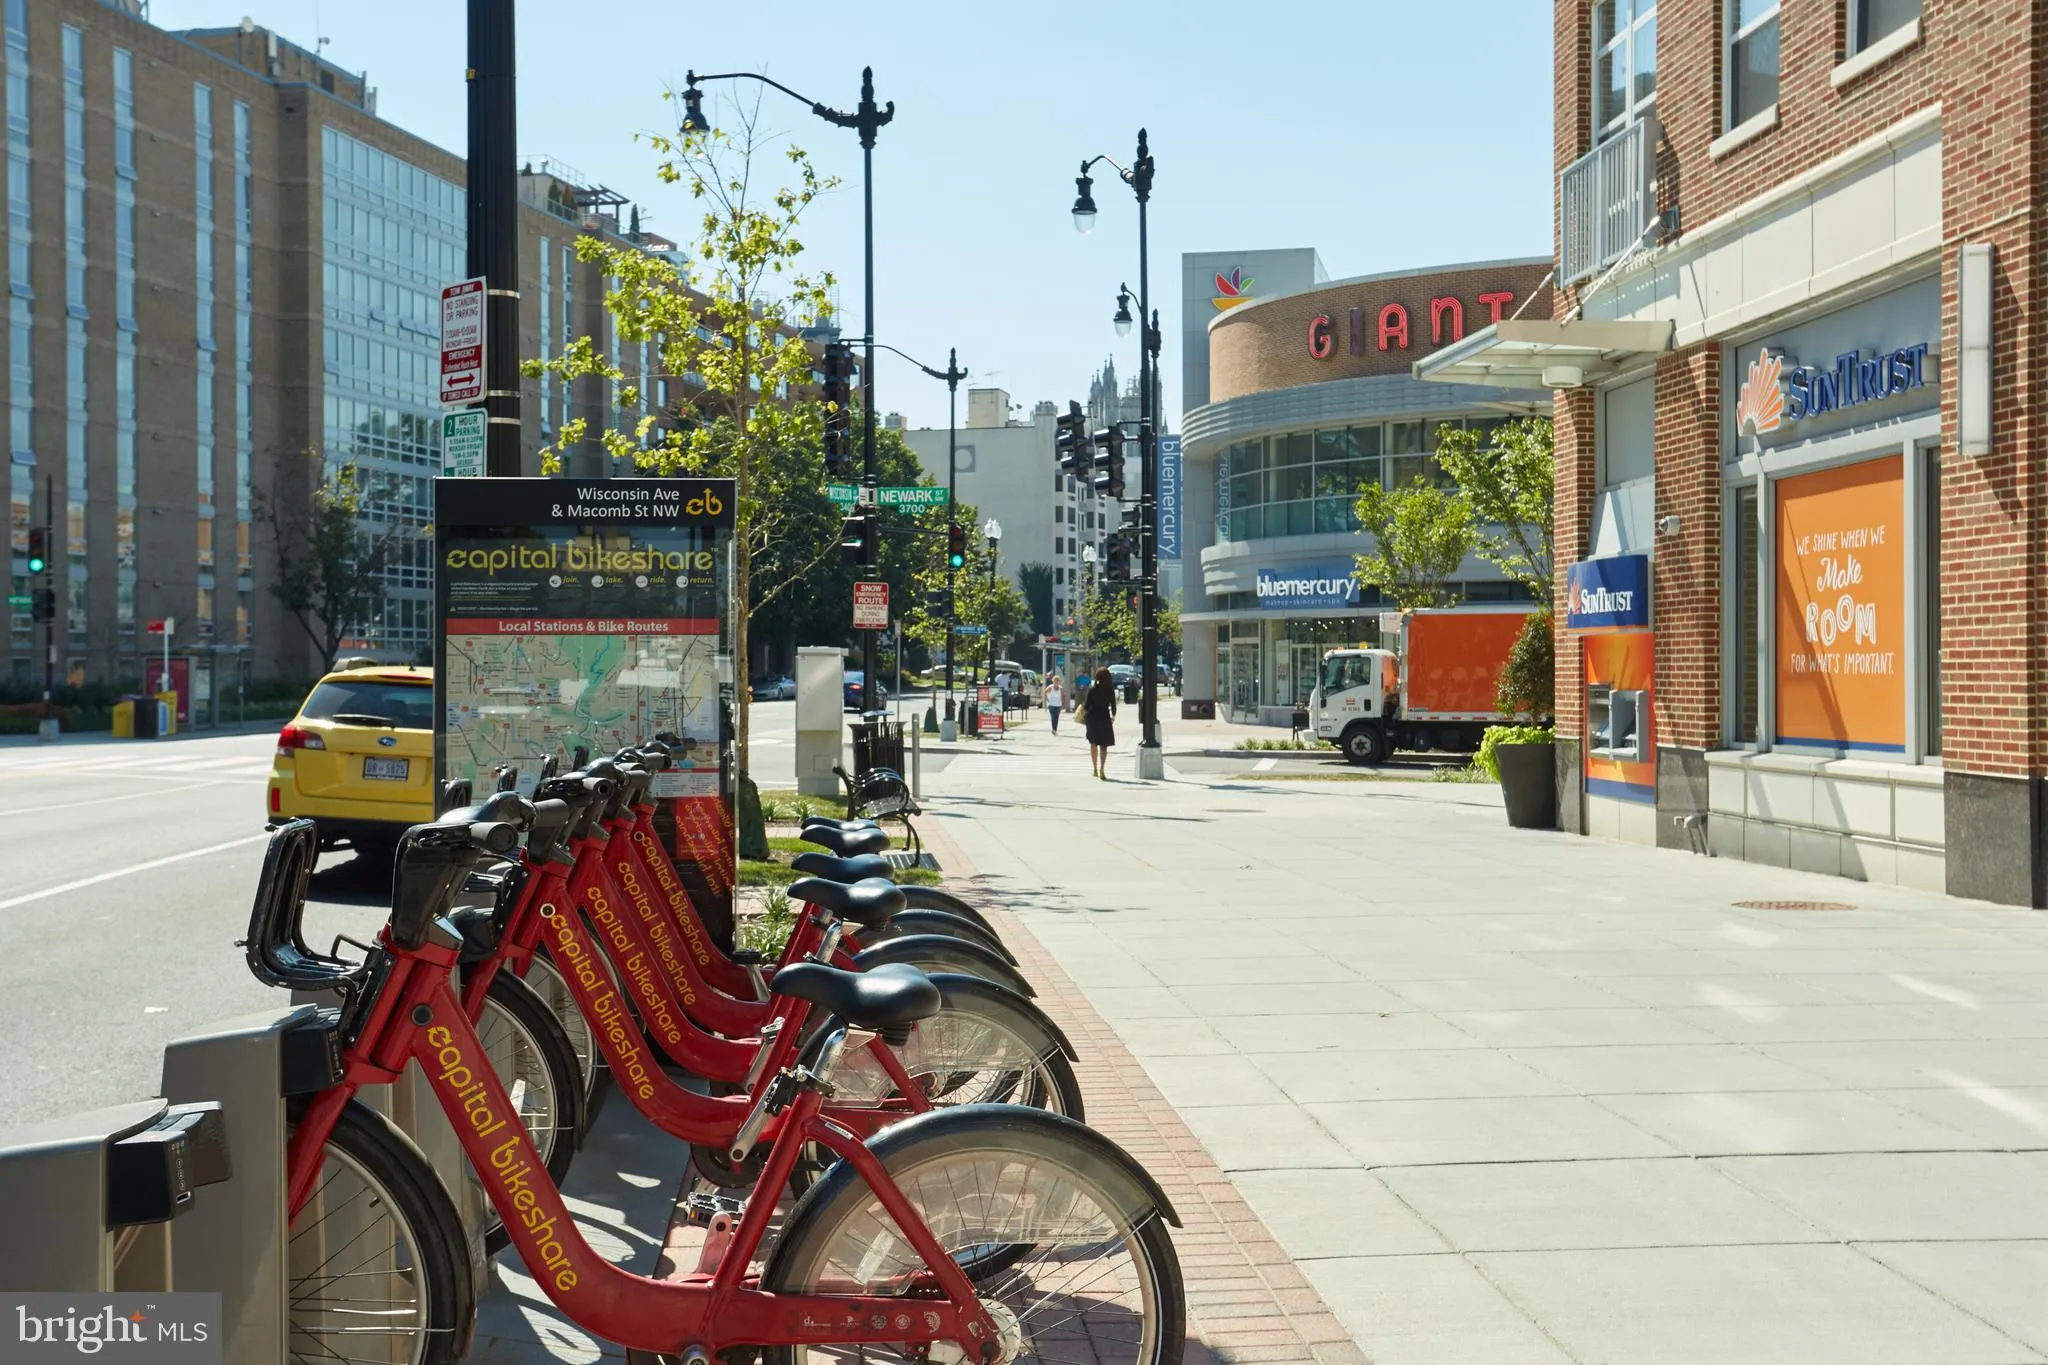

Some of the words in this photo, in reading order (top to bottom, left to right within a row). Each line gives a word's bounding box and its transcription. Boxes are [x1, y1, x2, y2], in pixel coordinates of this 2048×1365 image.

[446, 300, 454, 310] NO
[455, 295, 479, 309] STANDING
[446, 311, 454, 322] OR
[455, 306, 479, 319] PARKING
[1308, 292, 1514, 361] GIANT
[448, 347, 476, 361] EMERGENCY
[447, 419, 453, 435] 2
[455, 425, 481, 436] PARKING
[458, 415, 478, 426] HOUR
[577, 487, 650, 501] Wisconsin
[653, 488, 680, 501] Ave
[829, 487, 852, 500] WISCONSIN
[880, 490, 933, 503] NEWARK
[1158, 440, 1180, 555] bluemercury
[551, 505, 563, 517] &
[568, 504, 630, 517] Macomb
[634, 504, 649, 517] St
[653, 504, 679, 517] NW
[899, 504, 925, 513] 3700
[1796, 535, 1810, 556] WE
[1812, 532, 1838, 553] SHINE
[1840, 528, 1868, 550] WHEN
[1870, 525, 1886, 545] WE
[447, 543, 557, 576] capital
[567, 539, 713, 571] bikeshare
[1816, 553, 1864, 593] Make
[860, 584, 882, 592] SNOW
[1256, 575, 1357, 600] bluemercury
[499, 619, 531, 632] Local
[534, 620, 584, 632] Stations
[586, 620, 596, 632] &
[598, 619, 624, 632] Bike
[627, 620, 669, 632] Routes
[1805, 594, 1877, 647] ROOM
[1790, 652, 1806, 673] FOR
[1808, 652, 1841, 674] WHAT'S
[1844, 651, 1895, 675] IMPORTANT.
[641, 836, 678, 897] capital
[668, 890, 711, 967] bikeshare
[617, 862, 660, 923] capital
[649, 920, 697, 1006] bikeshare
[587, 886, 636, 954] capital
[626, 951, 682, 1045] bikeshare
[550, 914, 605, 992] capital
[593, 991, 656, 1100] bikeshare
[427, 1026, 508, 1139] capital
[490, 1135, 578, 1292] bikeshare
